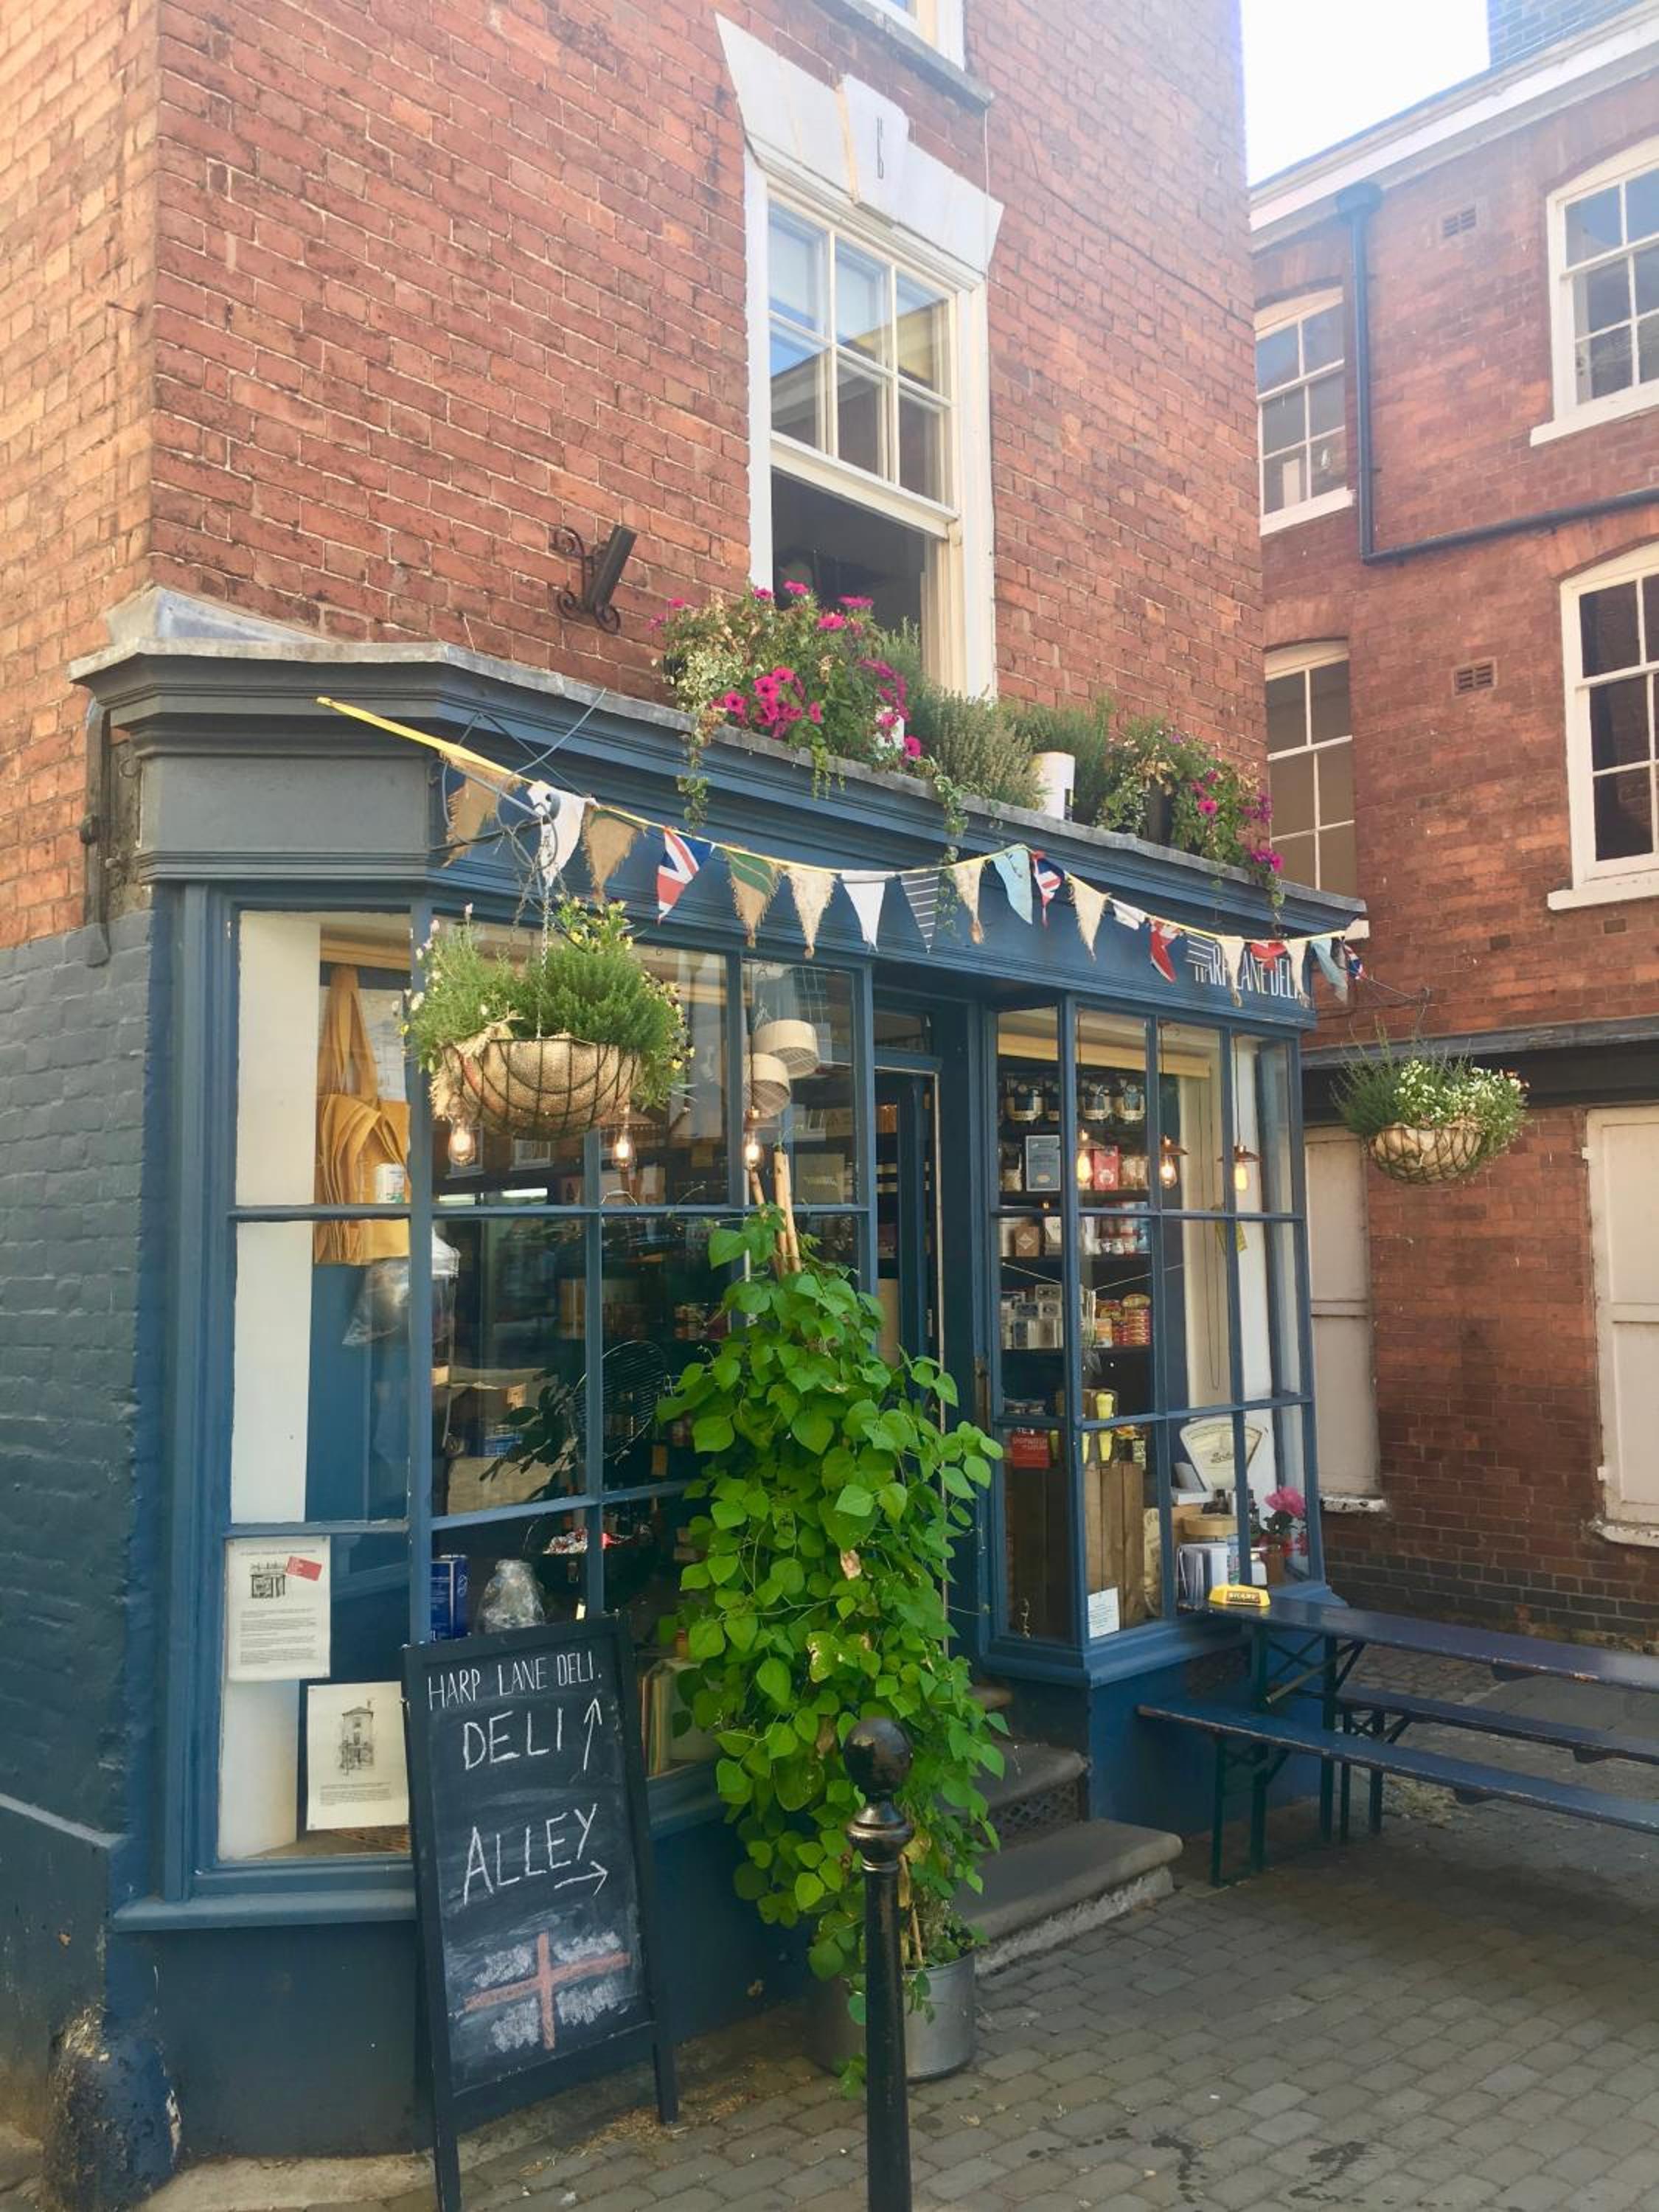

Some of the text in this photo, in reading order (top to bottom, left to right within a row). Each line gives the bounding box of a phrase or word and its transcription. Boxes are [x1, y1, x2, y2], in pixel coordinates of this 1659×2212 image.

[1234, 949, 1270, 995] ANE
[1270, 957, 1298, 999] DEL
[428, 1668, 481, 1711] HARP
[497, 1656, 549, 1697] LANE
[462, 1707, 563, 1770] DELI
[462, 1803, 598, 1907] ALLEY
